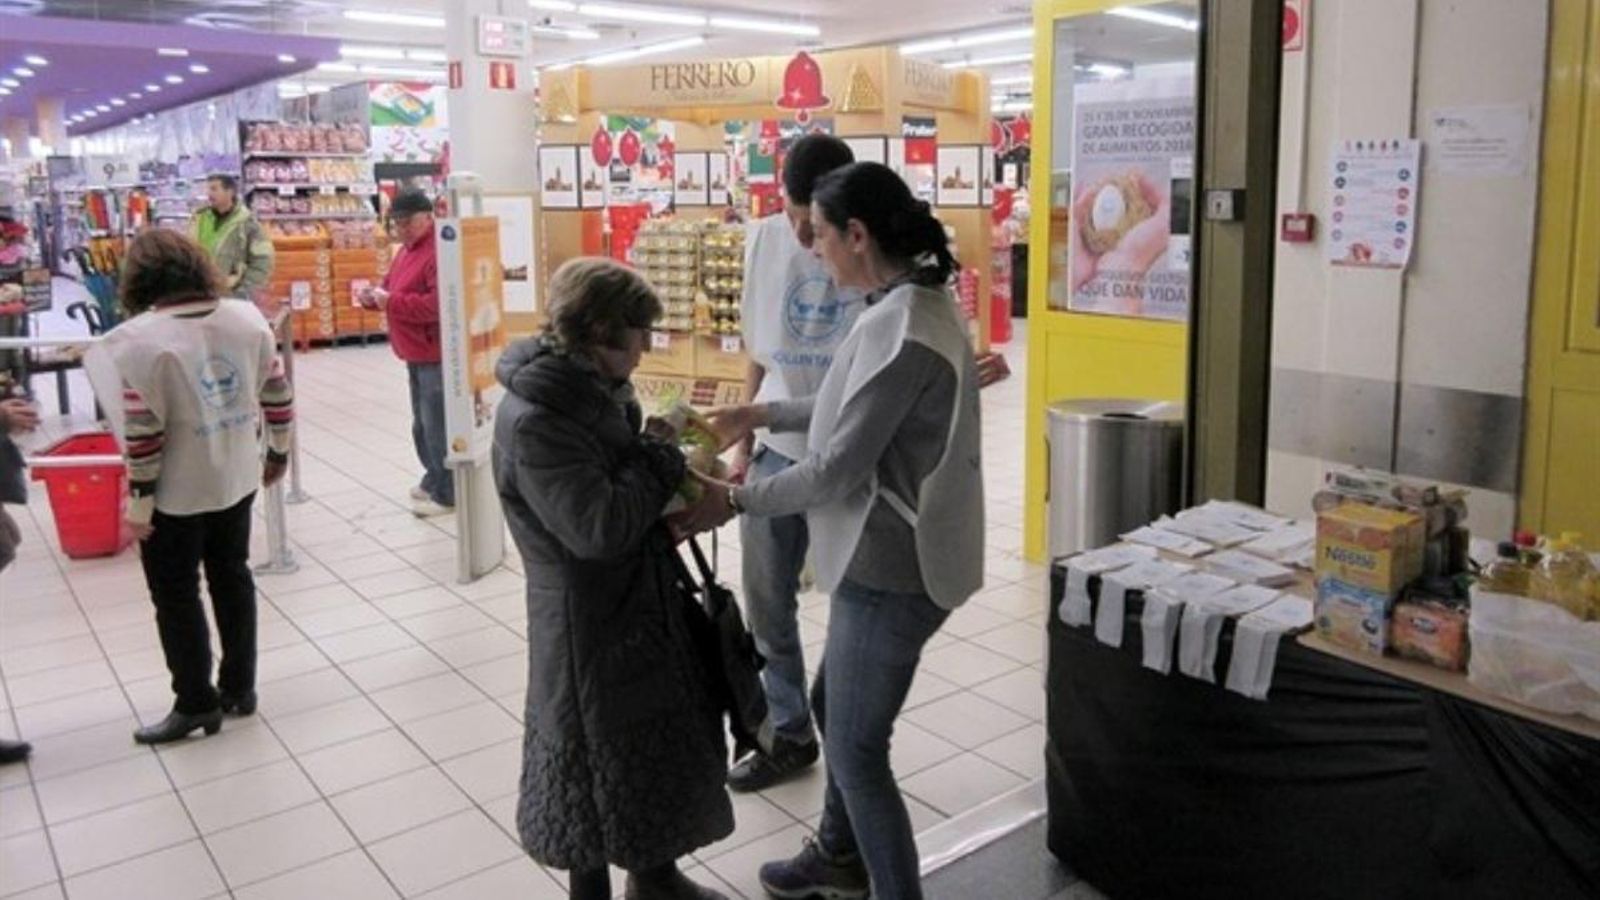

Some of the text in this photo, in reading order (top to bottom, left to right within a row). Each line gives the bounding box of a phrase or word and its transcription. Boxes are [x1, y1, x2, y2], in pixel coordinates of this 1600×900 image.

[651, 59, 756, 91] FERRERO
[1082, 120, 1193, 139] GRAN RECOGIDA
[1082, 141, 1096, 154] DE
[1098, 139, 1163, 154] ALIMENTOS
[1078, 280, 1187, 304] QUE DAN VIDA
[770, 350, 834, 367] OLUNTA
